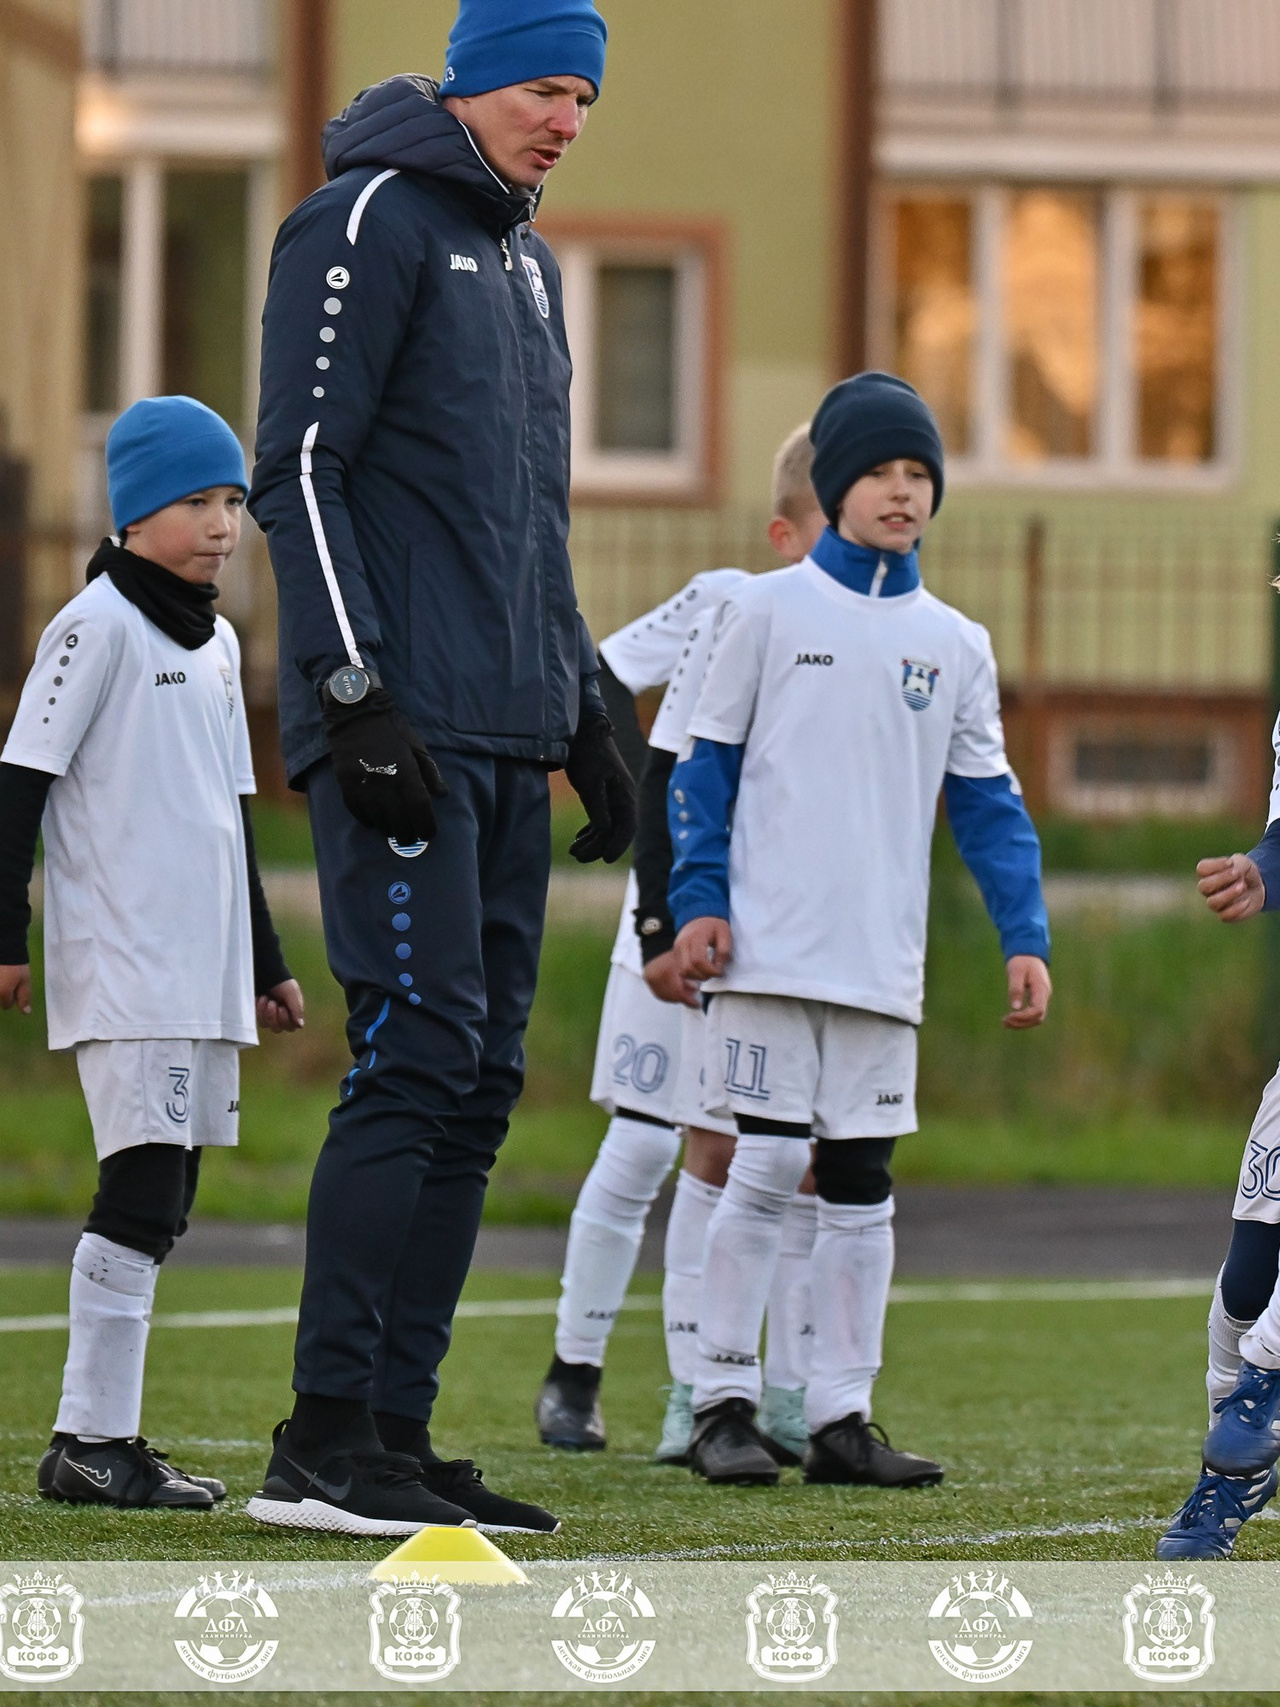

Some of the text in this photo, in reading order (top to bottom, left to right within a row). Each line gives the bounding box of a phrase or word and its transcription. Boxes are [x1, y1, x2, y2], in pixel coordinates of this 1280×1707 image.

[450, 253, 478, 273] JAKO
[795, 653, 834, 667] JAKO
[155, 671, 187, 687] JAKO
[613, 1033, 669, 1094] 20
[724, 1037, 771, 1101] 11
[165, 1066, 190, 1123] 3
[667, 1321, 698, 1335] JAK
